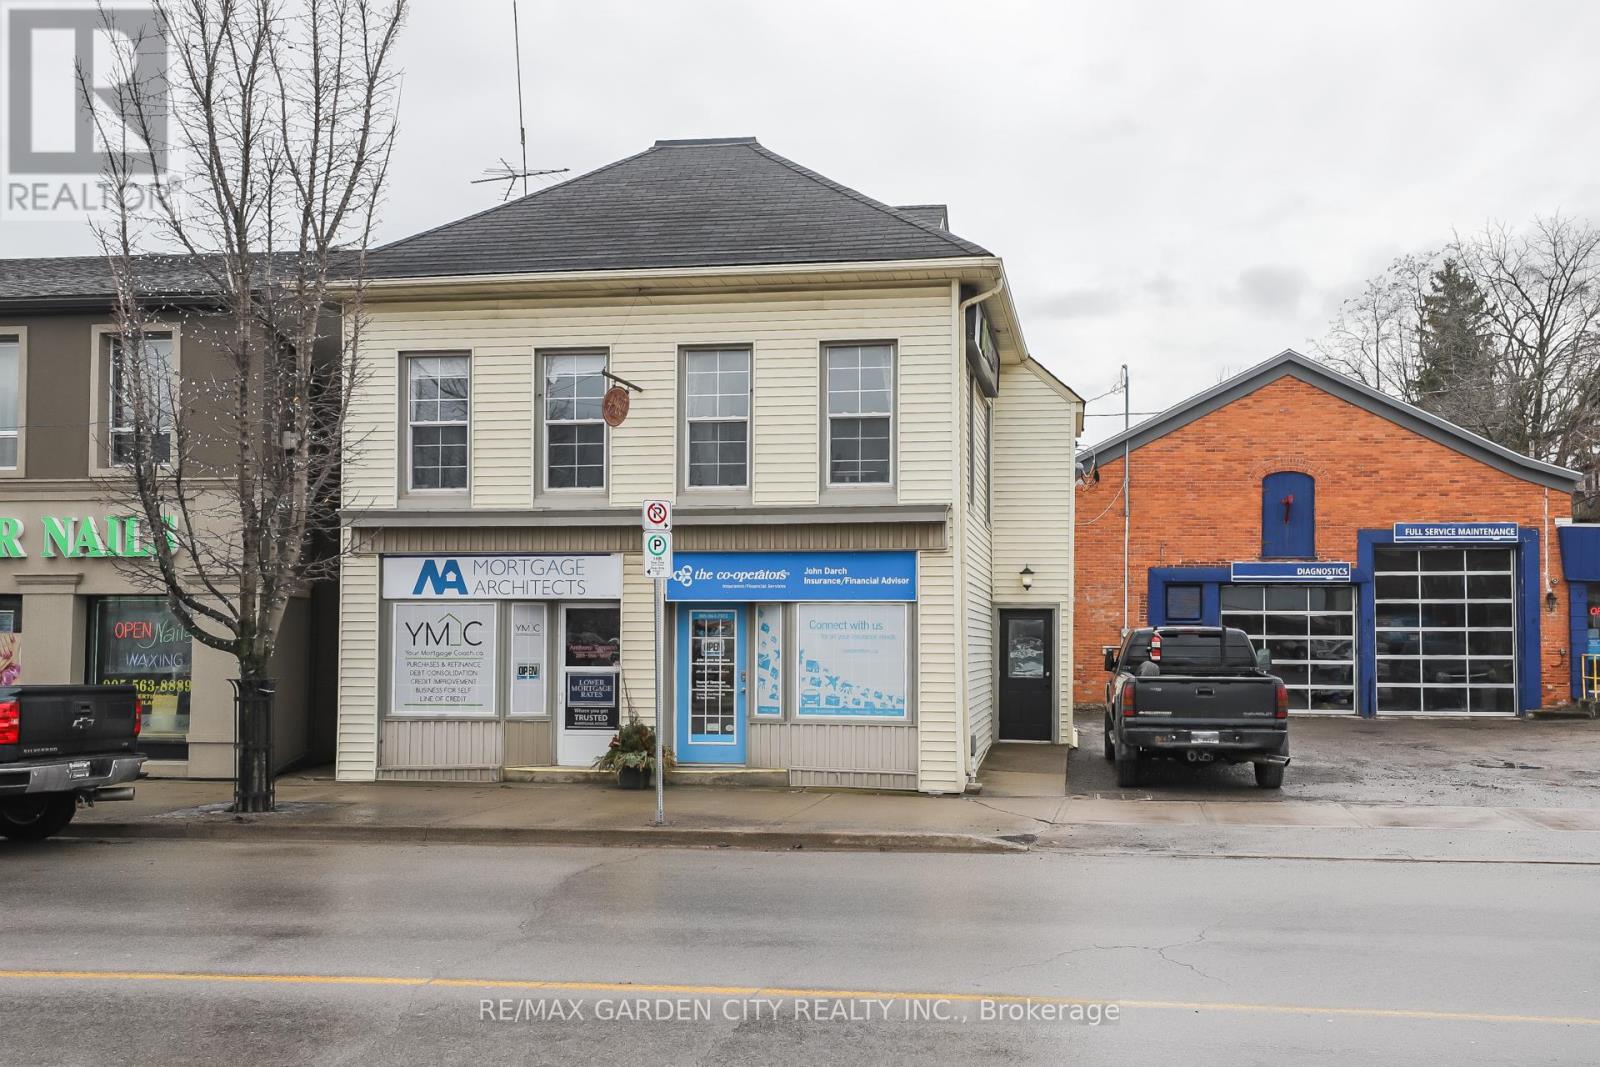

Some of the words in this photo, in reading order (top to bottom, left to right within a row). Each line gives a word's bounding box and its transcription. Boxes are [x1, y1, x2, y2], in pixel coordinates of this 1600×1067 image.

[1405, 528, 1423, 536] FULL
[1425, 528, 1456, 536] SERVICE
[1458, 528, 1516, 537] MAINTENANCE
[473, 558, 585, 577] MORTGAGE
[803, 567, 822, 575] John
[824, 567, 848, 575] Darch
[1297, 567, 1348, 576] DIAGNOSTICS
[694, 567, 714, 580] the
[716, 568, 787, 583] co-operators
[803, 576, 879, 586] Insurance/Financial
[881, 576, 910, 585] Advisor
[473, 579, 586, 596] ARCHITECTS
[809, 619, 847, 630] Connect
[849, 619, 870, 630] with
[871, 622, 885, 630] us
[115, 621, 153, 639] OPEN
[137, 619, 193, 649] Nails
[126, 652, 184, 668] WAXING
[518, 665, 538, 676] OPEN
